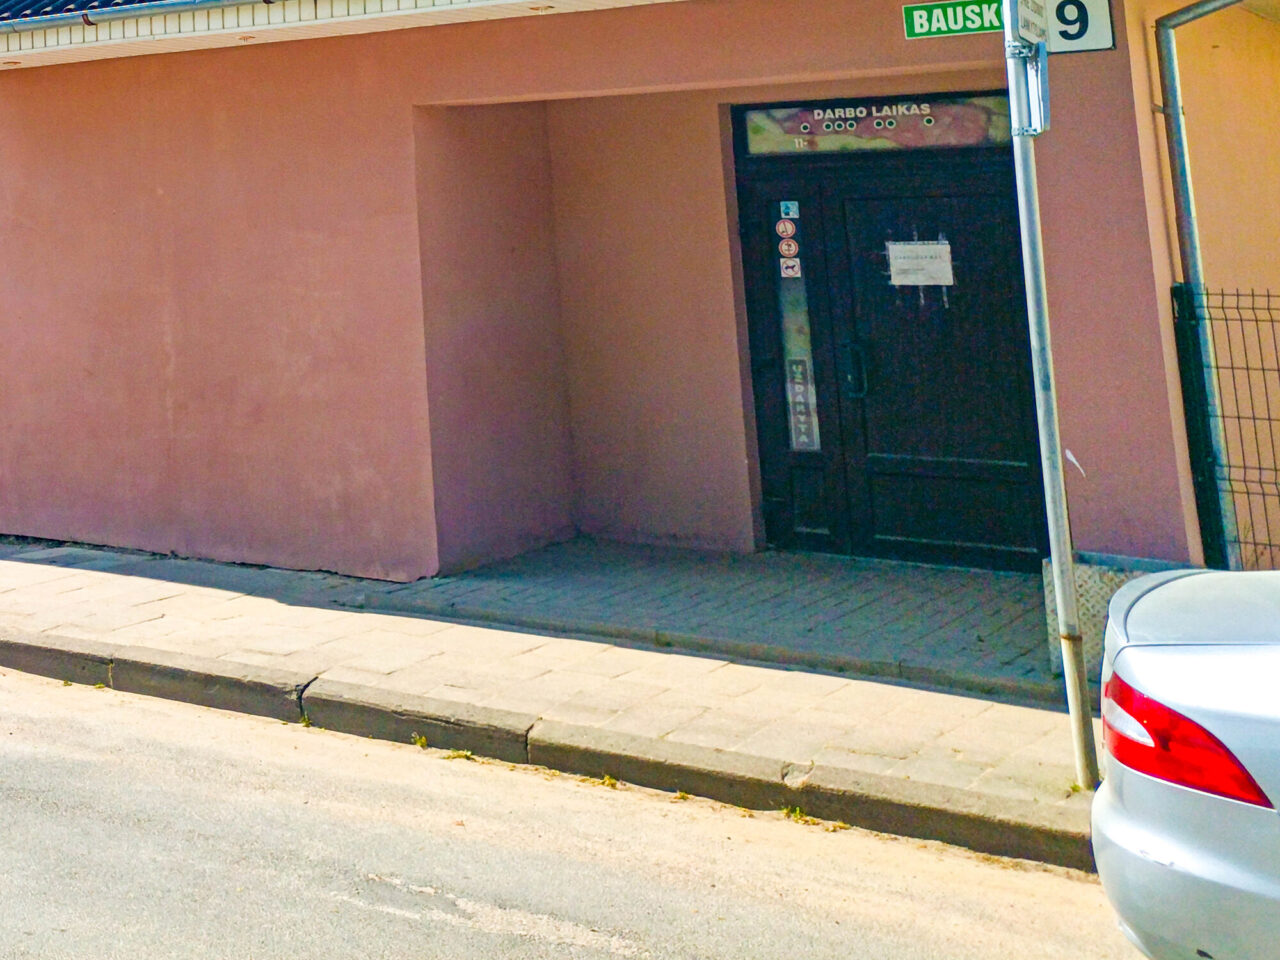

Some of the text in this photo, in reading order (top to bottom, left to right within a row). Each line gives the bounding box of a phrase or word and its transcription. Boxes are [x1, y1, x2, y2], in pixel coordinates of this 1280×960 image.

[913, 3, 1003, 33] BAUSK
[813, 103, 931, 120] DARBO LAIKAS
